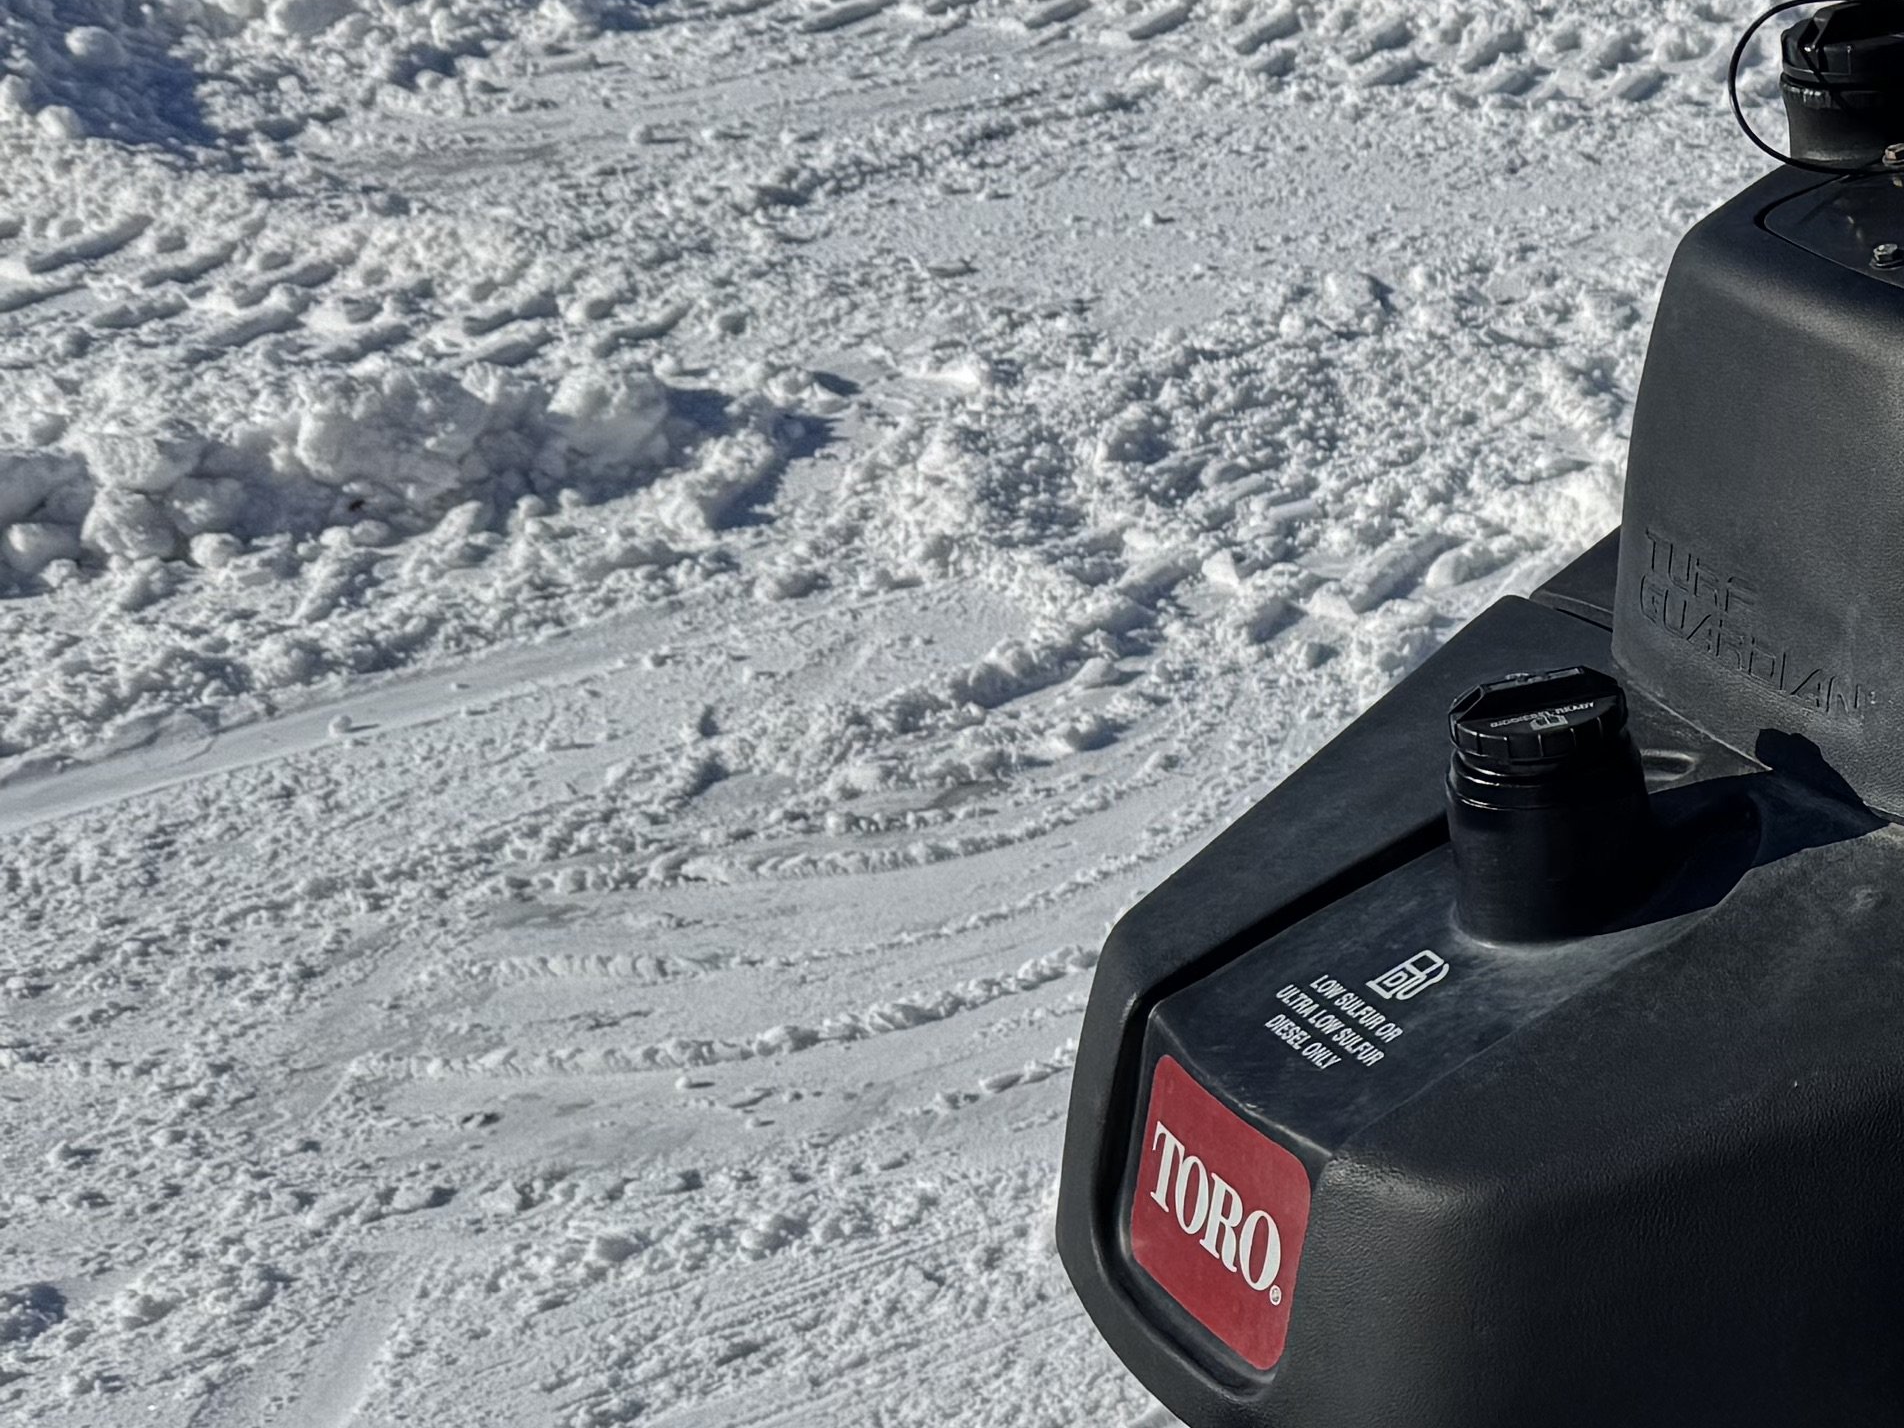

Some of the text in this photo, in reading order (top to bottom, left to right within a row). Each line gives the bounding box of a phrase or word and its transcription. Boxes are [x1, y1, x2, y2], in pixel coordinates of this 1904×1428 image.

[1264, 1013, 1342, 1070] DIESEL ONLY
[1275, 984, 1385, 1067] ULTRA LOW SULFUR
[1309, 974, 1404, 1043] LOW SULFUR OR
[1150, 1120, 1282, 1292] TORO
